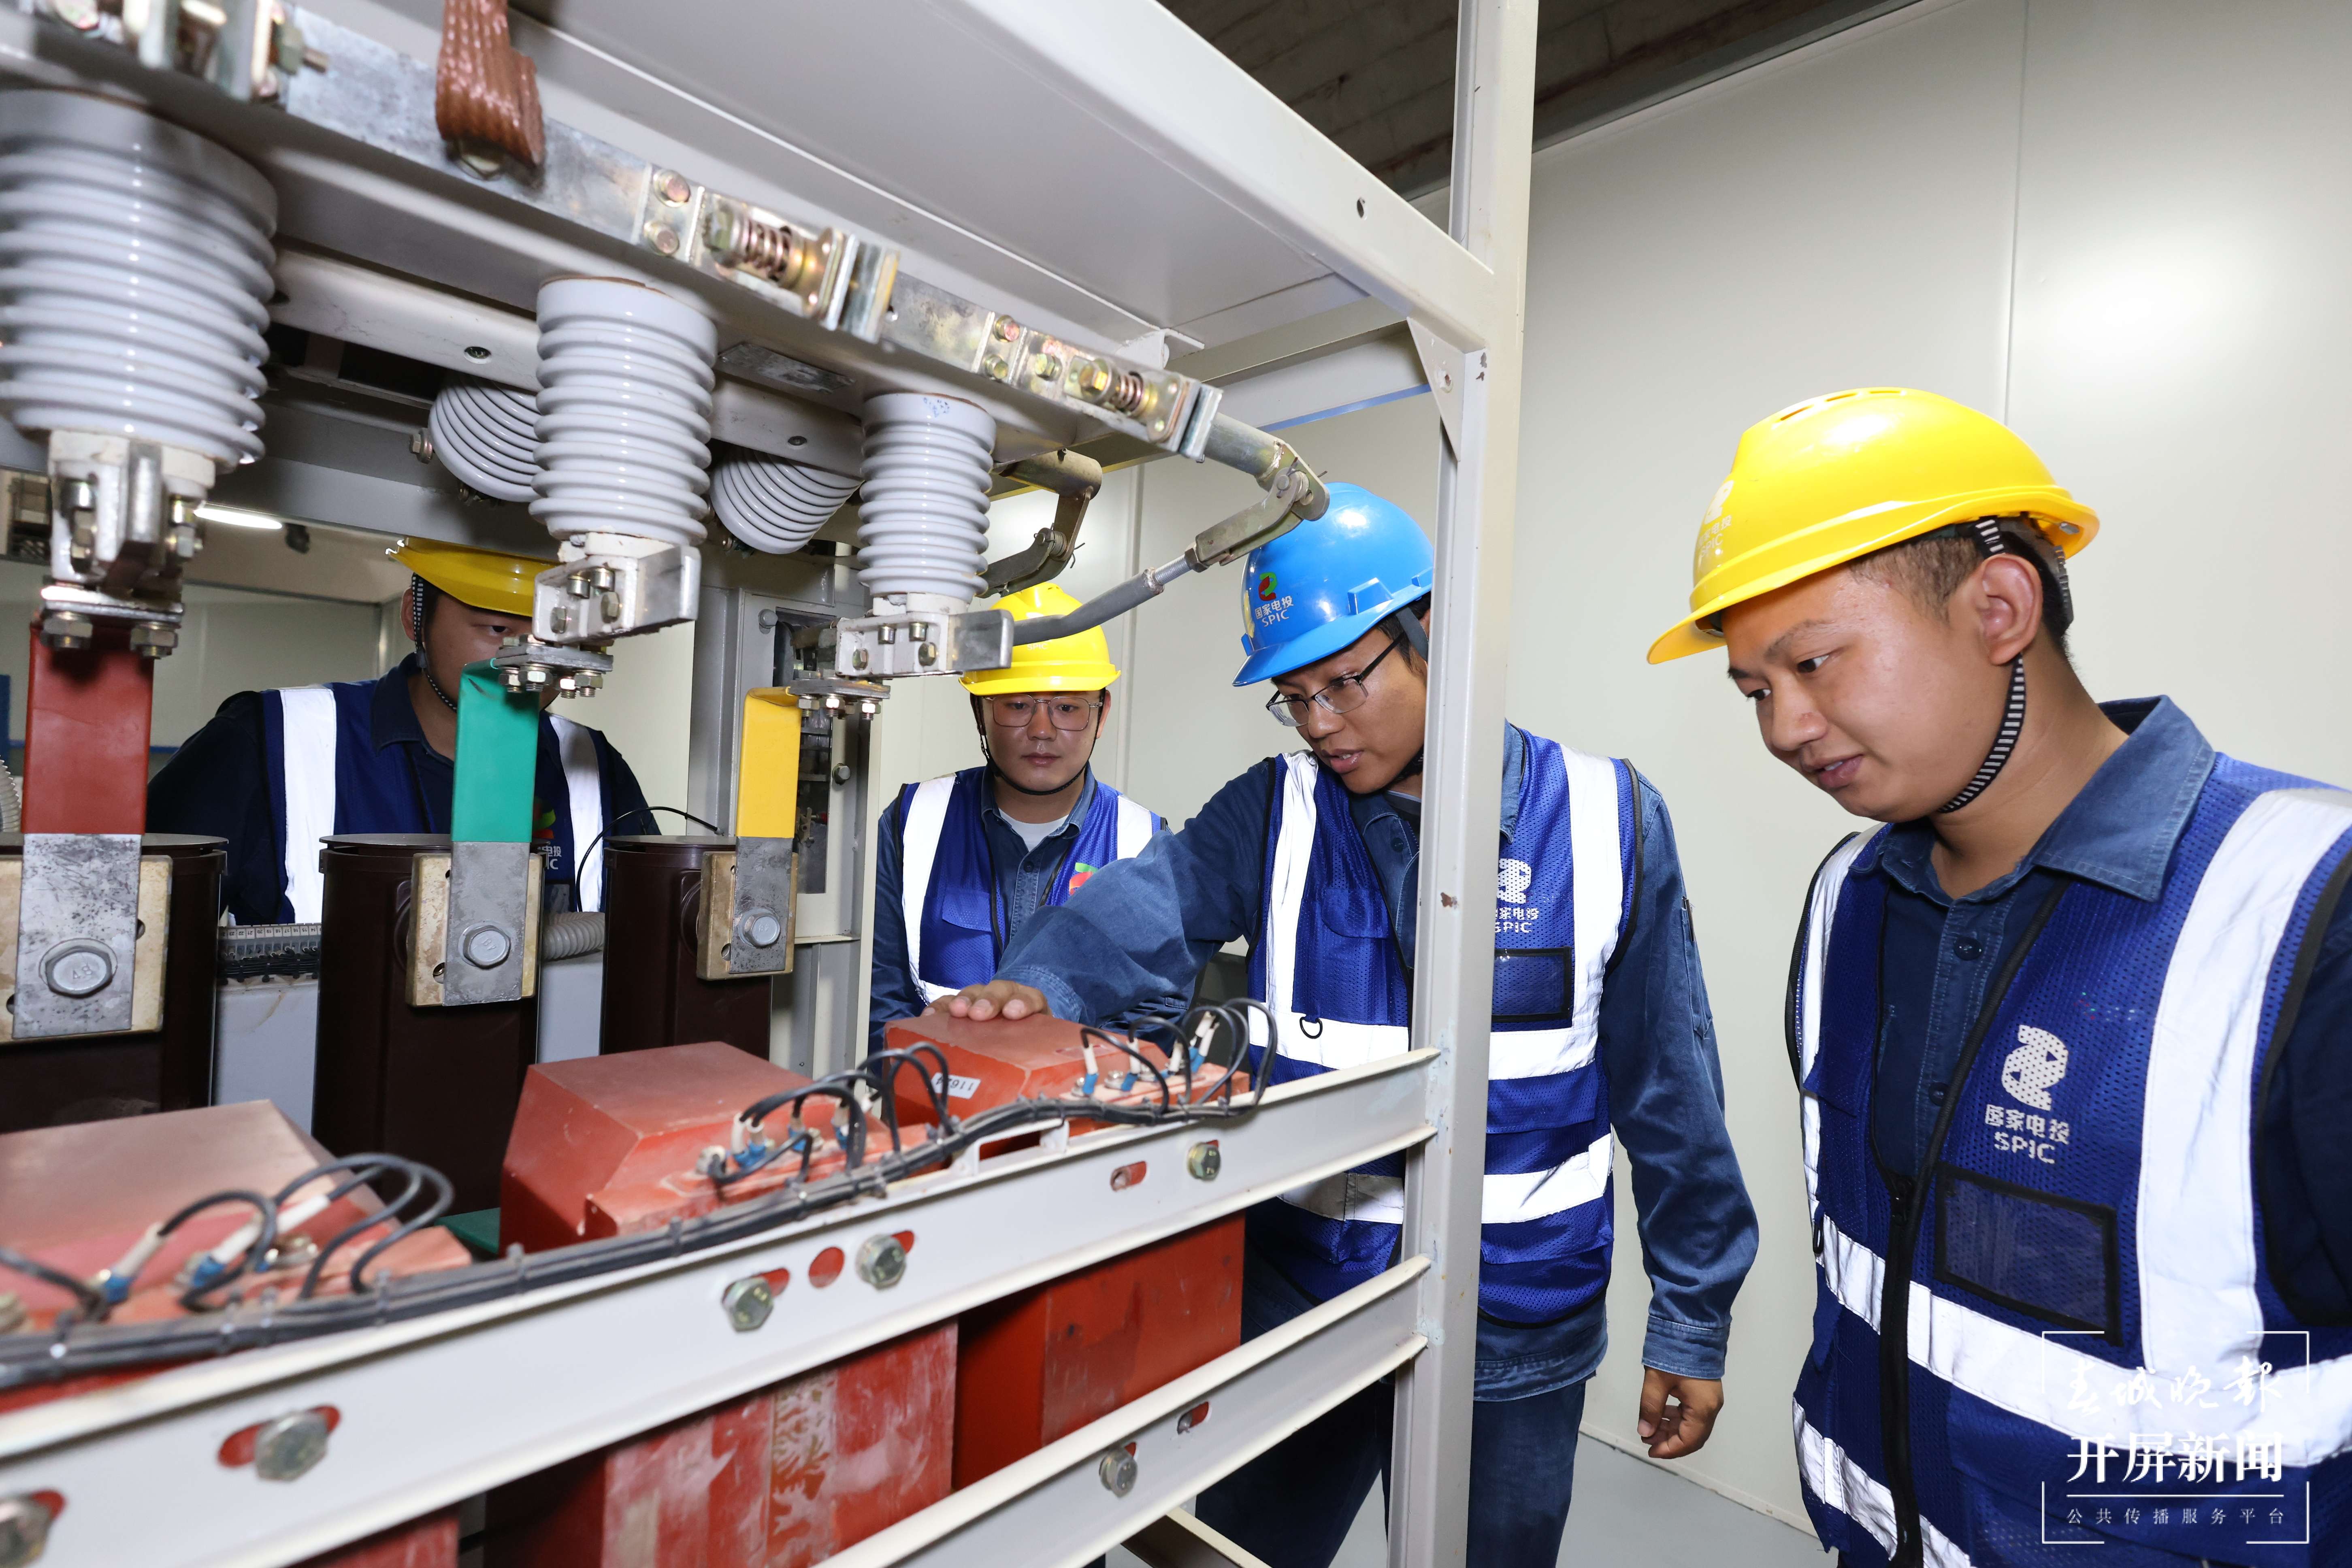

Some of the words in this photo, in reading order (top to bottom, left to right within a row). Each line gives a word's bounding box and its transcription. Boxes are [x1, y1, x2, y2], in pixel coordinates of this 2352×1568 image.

[1698, 515, 1732, 546] 家电投
[1255, 596, 1294, 619] 国家电投
[1262, 609, 1289, 627] SPIC
[537, 846, 562, 857] 电投
[1495, 907, 1539, 920] 家电投
[936, 1075, 974, 1091] 1164
[1985, 1104, 2070, 1145] 国家电投
[1994, 1132, 2056, 1164] SPIC
